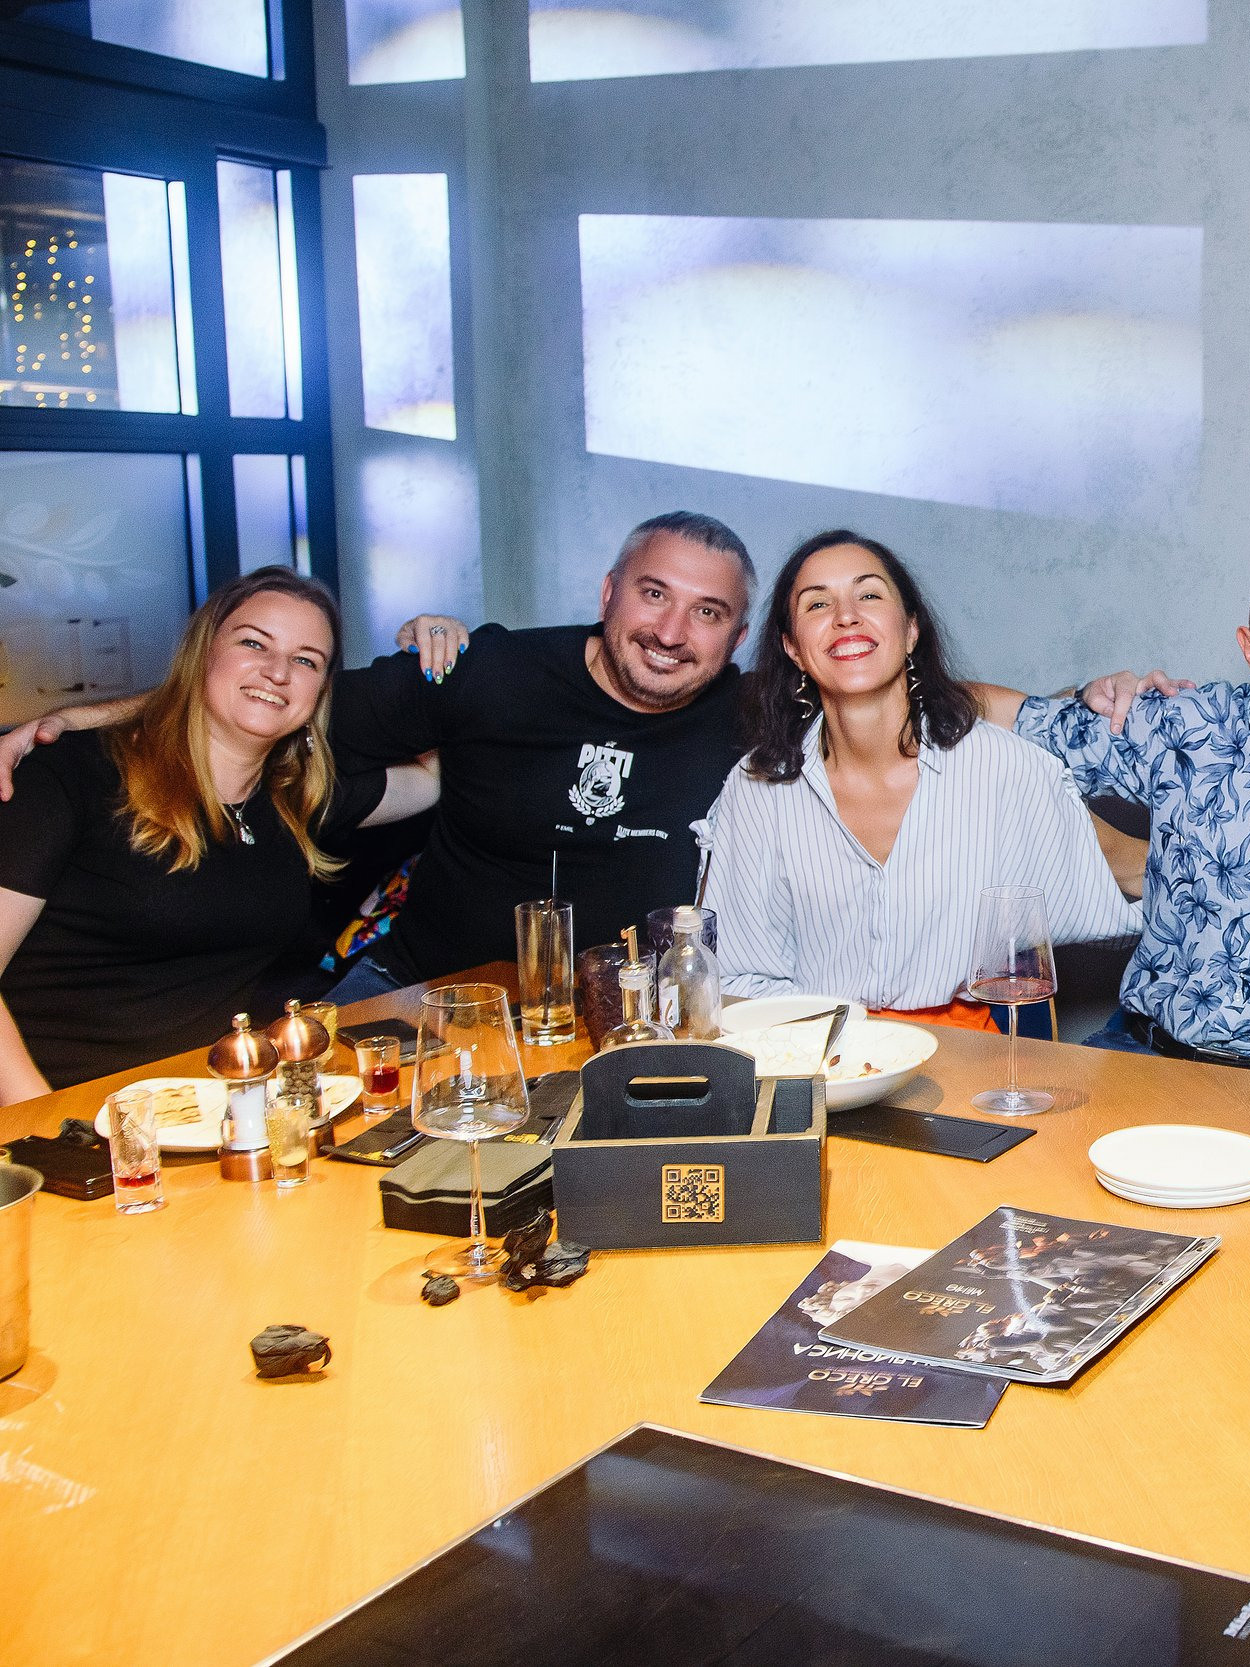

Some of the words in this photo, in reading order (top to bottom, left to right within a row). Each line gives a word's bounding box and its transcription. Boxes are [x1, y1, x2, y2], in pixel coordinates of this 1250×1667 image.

[577, 743, 634, 778] PITTI
[903, 1290, 971, 1312] GRECO
[975, 1302, 996, 1315] EL
[807, 1368, 893, 1388] GRECO
[898, 1374, 925, 1389] EL
